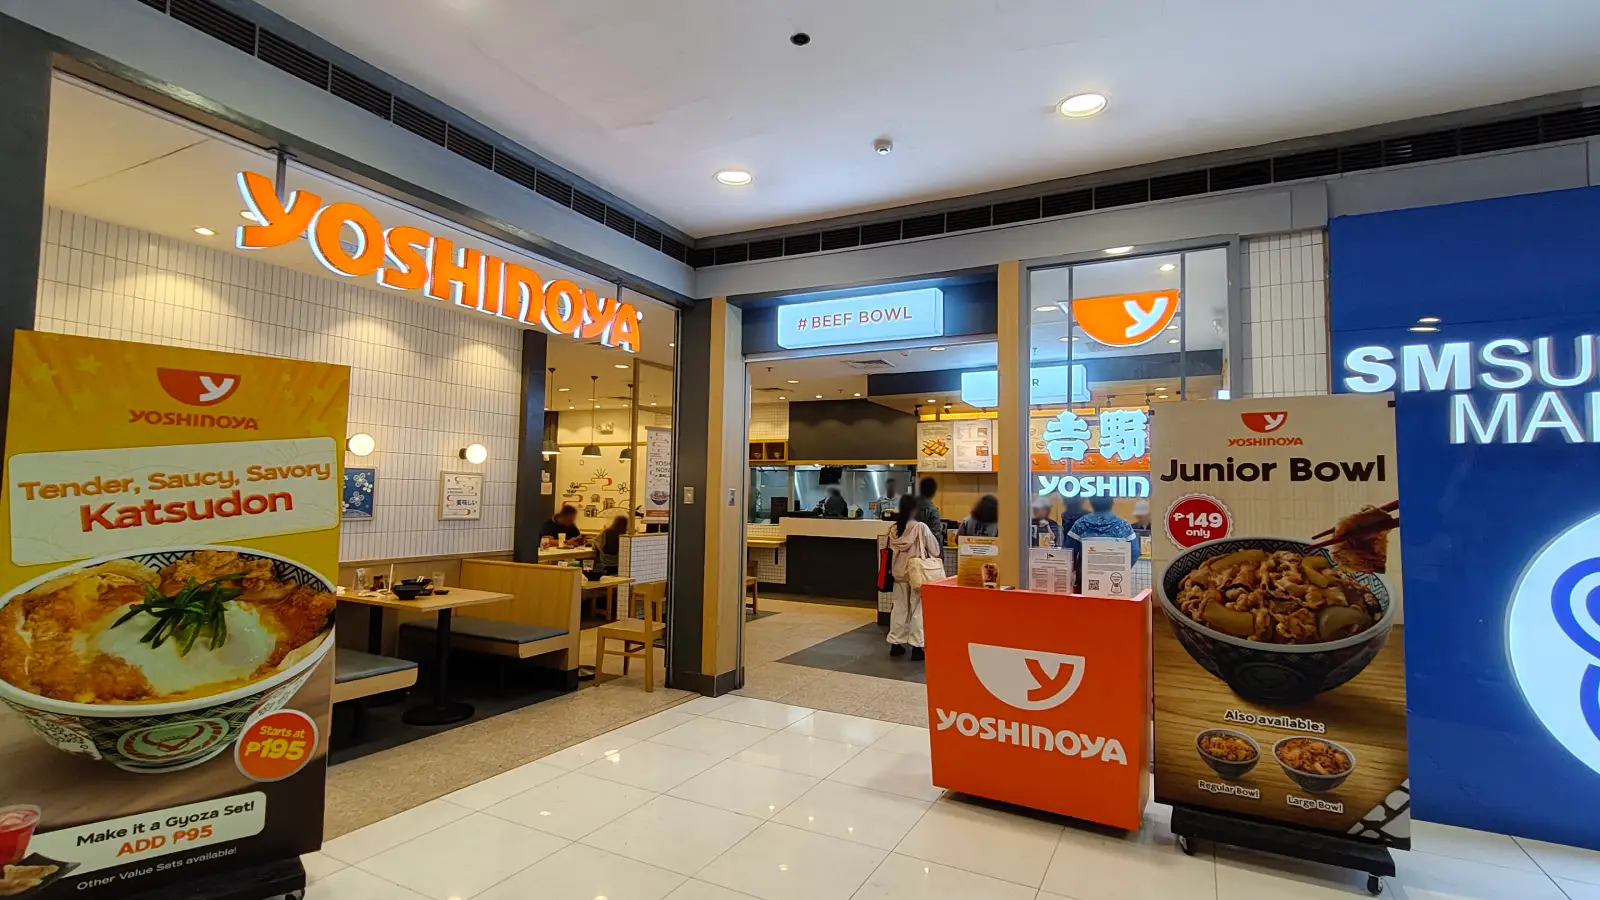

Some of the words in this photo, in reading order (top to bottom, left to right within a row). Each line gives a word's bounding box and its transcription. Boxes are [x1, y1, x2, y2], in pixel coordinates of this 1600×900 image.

[236, 171, 641, 353] YOSHINOYA
[811, 313, 853, 329] BEEF
[859, 306, 913, 323] BOWL
[1478, 334, 1600, 390] SU
[129, 410, 260, 431] YOSHINOYA
[1043, 410, 1148, 461] 吉野
[1227, 437, 1304, 447] YOSHINOYA
[18, 475, 141, 501] Tender,
[147, 468, 241, 491] Saucy,
[246, 462, 331, 482] Savory
[1160, 456, 1278, 483] Junior
[1289, 455, 1386, 482] Bowl
[80, 489, 294, 532] Katsudon
[1186, 528, 1211, 539] only
[259, 725, 292, 738] Starts
[293, 729, 306, 739] at
[1224, 709, 1255, 724] Also
[1258, 715, 1326, 733] available:
[936, 708, 1128, 766] YOSHINOYA
[1198, 780, 1235, 795] Regular
[1236, 787, 1260, 799] Bowl
[1287, 795, 1316, 810] Large
[1318, 801, 1344, 814] Bowl
[76, 828, 128, 847] Make
[132, 822, 146, 835] it
[150, 821, 161, 832] a
[165, 809, 219, 828] Gyoza
[223, 800, 255, 817] Set!
[116, 834, 166, 858] ADD
[76, 874, 116, 891] Other
[119, 866, 154, 881] Value
[156, 859, 184, 873] Sets
[186, 846, 238, 866] available!
